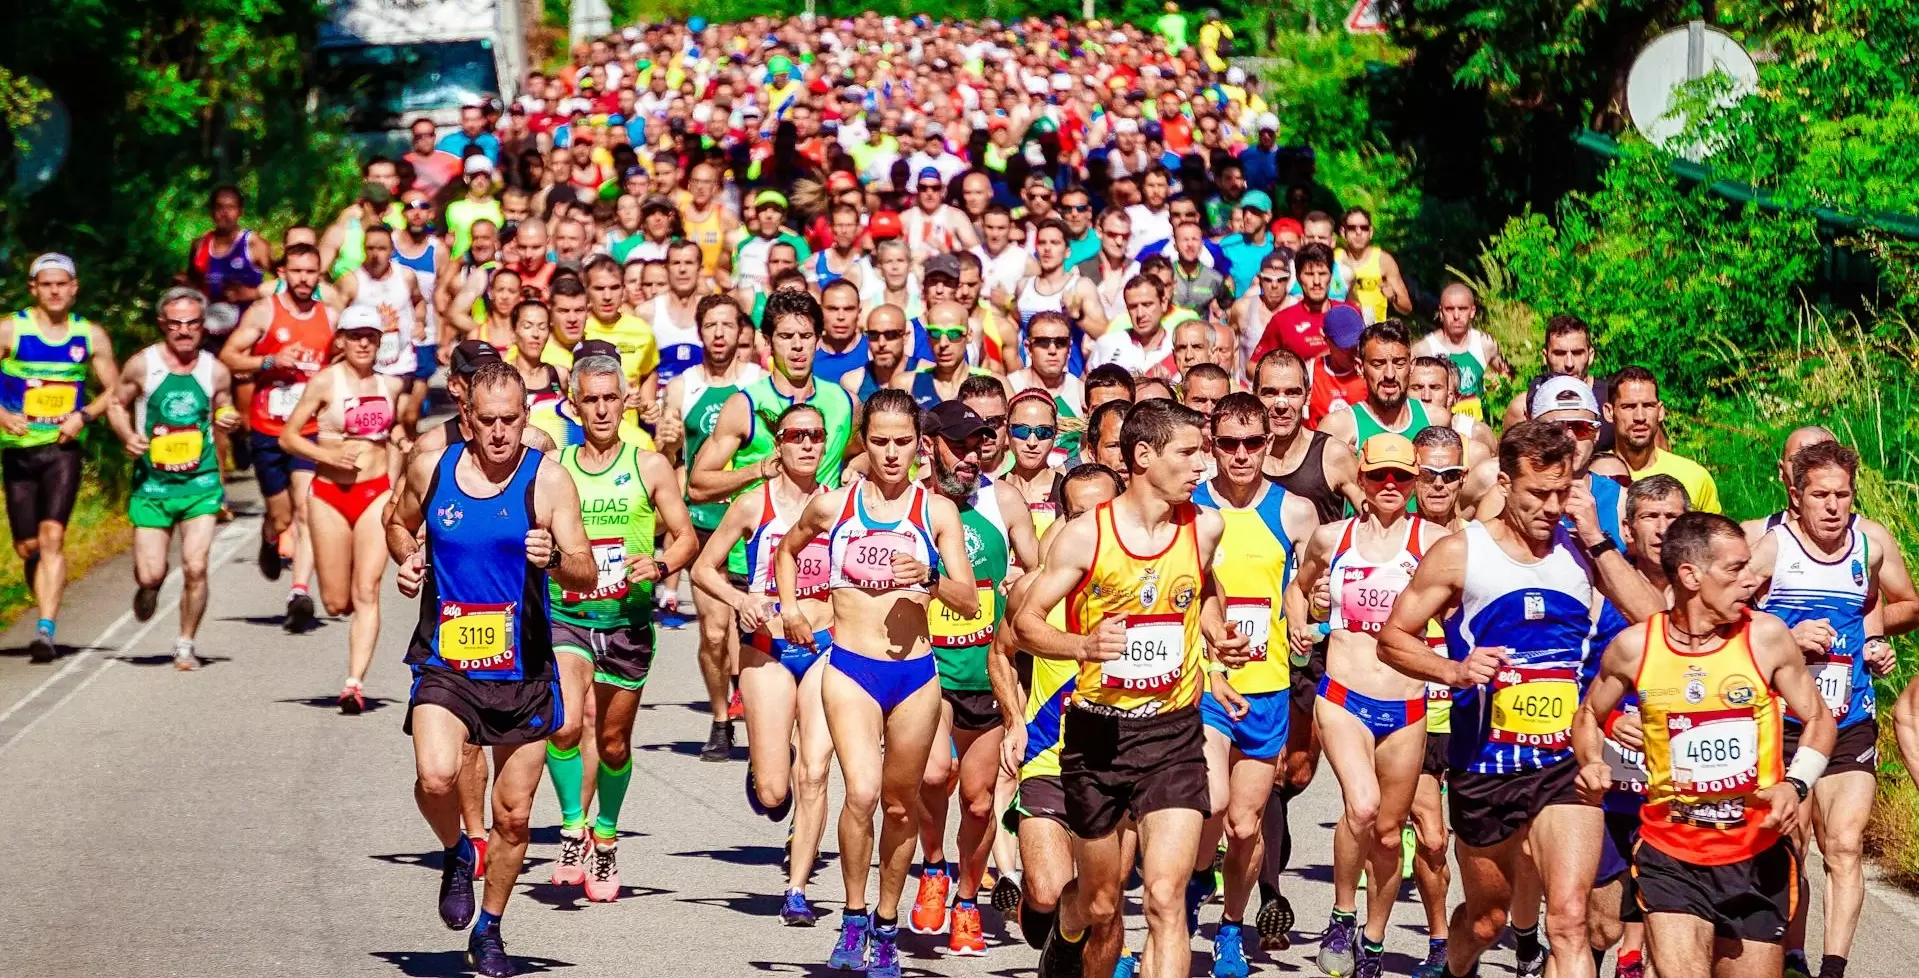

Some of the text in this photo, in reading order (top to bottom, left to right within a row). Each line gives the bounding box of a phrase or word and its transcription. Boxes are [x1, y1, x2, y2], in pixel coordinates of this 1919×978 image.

[354, 412, 384, 427] 4685
[856, 545, 897, 566] 382
[1357, 588, 1399, 608] 3827
[443, 604, 462, 619] edp
[458, 626, 495, 645] 3119
[946, 625, 994, 645] DOURO
[459, 650, 513, 669] DOURO
[1123, 668, 1182, 690] DOURO
[1498, 669, 1522, 686] edp
[1512, 695, 1563, 718] 4620
[1687, 738, 1741, 762] 4686
[1696, 766, 1758, 793] DOURO
